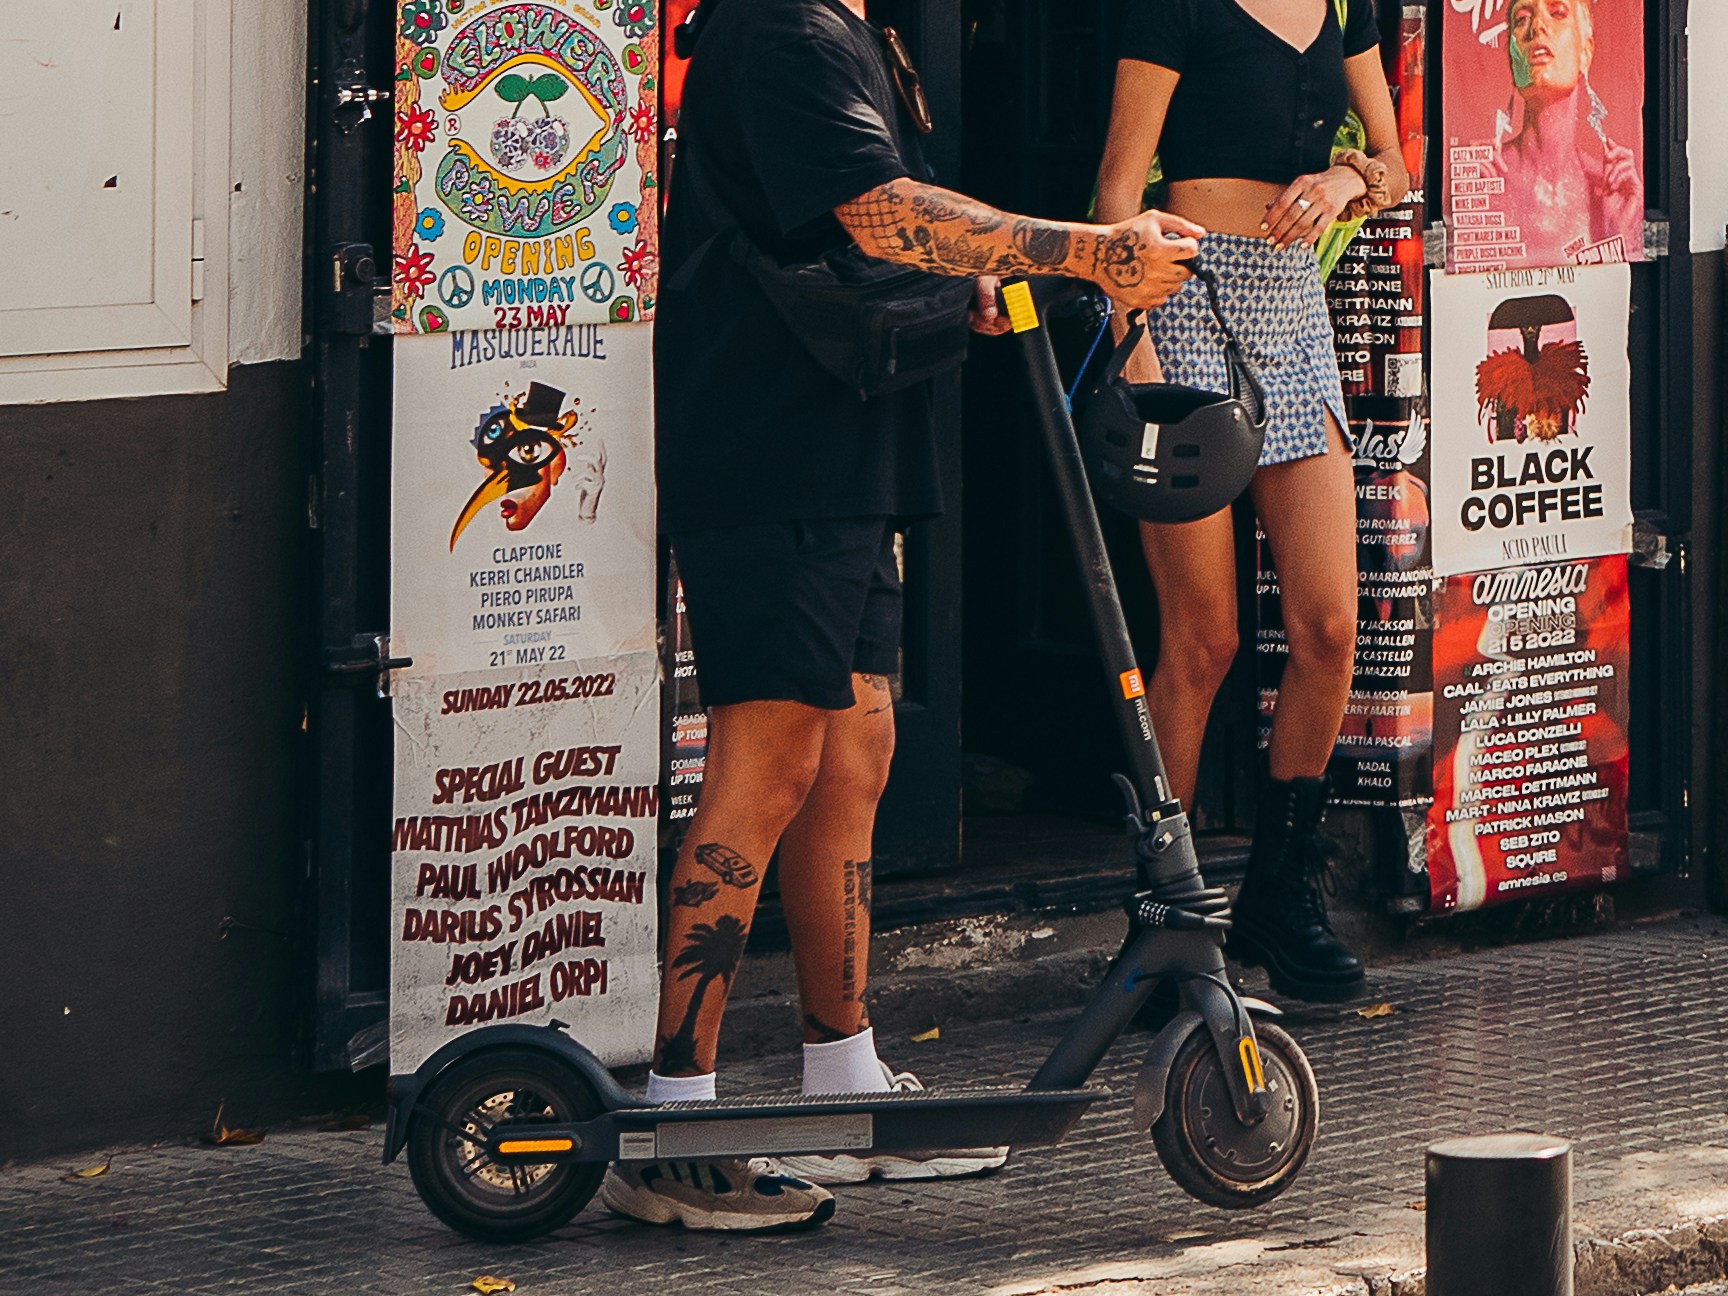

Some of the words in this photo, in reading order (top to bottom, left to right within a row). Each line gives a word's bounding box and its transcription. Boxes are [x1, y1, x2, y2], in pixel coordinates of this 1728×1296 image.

[440, 155, 627, 232] POWER
[463, 227, 596, 275] OPENING
[482, 275, 576, 306] MONDAY
[1328, 280, 1402, 292] FARAONE
[1486, 267, 1536, 289] SATURDAY
[1556, 266, 1576, 285] MAY
[494, 306, 522, 329] 23
[526, 303, 571, 328] MAY
[450, 323, 607, 370] MASQUERADE
[1338, 332, 1396, 344] MASON
[1378, 461, 1403, 470] CLUB
[1471, 446, 1594, 491] BLACK
[1461, 484, 1604, 532] COFFEE
[1371, 518, 1411, 531] ROMAN
[1361, 532, 1417, 545] GUTIERREZ
[1501, 536, 1529, 560] ACID
[1532, 534, 1568, 557] PAULI
[492, 543, 562, 564] CLAPTONE
[469, 569, 510, 588] KERRI
[514, 562, 585, 584] CHANDLER
[1472, 563, 1589, 605] amnesia
[481, 589, 522, 608] PIERO
[526, 585, 573, 604] PIRUPA
[1371, 585, 1427, 598] LEONARDO
[472, 610, 533, 631] MONKEY
[536, 605, 581, 625] SAFARI
[1487, 596, 1576, 622] OPENING
[503, 630, 552, 646] SATURDAY
[1367, 619, 1414, 631] JACKSON
[1487, 612, 1576, 638] OPENING
[1373, 634, 1415, 647] MALLEN
[1487, 637, 1507, 655] 21
[1509, 634, 1523, 651] 5
[1526, 628, 1576, 650] 2022
[516, 647, 546, 665] MAY
[549, 644, 566, 661] 22
[1362, 649, 1414, 662] CASTELLO
[1472, 658, 1526, 677] ARCHIE
[1527, 649, 1596, 670] HAMILTON
[1365, 665, 1411, 677] MAZZALI
[1443, 682, 1484, 699] CAAL
[1491, 676, 1529, 693] EATS
[1529, 664, 1614, 684] EVERYTHING
[440, 681, 515, 715] SUNDAY
[516, 672, 616, 706] 22.05.2022
[1373, 690, 1408, 701] MOON
[1460, 698, 1505, 714] JAMIE
[1506, 691, 1553, 709] JONES
[1134, 698, 1152, 742] mi.com
[1370, 705, 1412, 716] MARTIN
[1460, 716, 1500, 733] LALA
[1507, 709, 1542, 726] LILLY
[1542, 702, 1597, 721] PALMER
[672, 730, 685, 743] UP
[1336, 735, 1373, 746] MATTIA
[1374, 735, 1413, 748] PASCAL
[1476, 731, 1516, 748] LUCA
[1517, 722, 1582, 743] DONZELLI
[1357, 761, 1392, 772] NADAL
[1470, 748, 1523, 766] MACEO
[1525, 742, 1559, 760] PLEX
[431, 756, 525, 805] SPECIAL
[532, 744, 623, 786] GUEST
[670, 774, 684, 786] UP
[1469, 765, 1524, 783] MARCO
[1525, 755, 1588, 776] FARAONE
[1357, 777, 1392, 788] KHALO
[1460, 784, 1520, 803] MARCEL
[1521, 771, 1597, 795] DETTMANN
[671, 794, 693, 806] WEEK
[1497, 799, 1532, 815] NINA
[1533, 790, 1581, 809] KRAVIZ
[391, 805, 508, 854] MATTHIAS
[511, 784, 660, 837] TANZMANN
[1474, 816, 1532, 836] PATRICK
[1533, 808, 1585, 827] MASON
[1499, 836, 1529, 851] SEB
[1530, 830, 1561, 847] ZITO
[416, 862, 482, 902] PAUL
[487, 825, 635, 898] WOOLFORD
[1505, 849, 1557, 869] SQUIRE
[401, 907, 503, 943] DARIUS
[507, 864, 647, 934] SYROSSIAN
[444, 940, 517, 987] JOEY
[520, 910, 607, 971] DANIEL
[444, 975, 545, 1027] DANIEL
[549, 957, 609, 1003] ORPI
